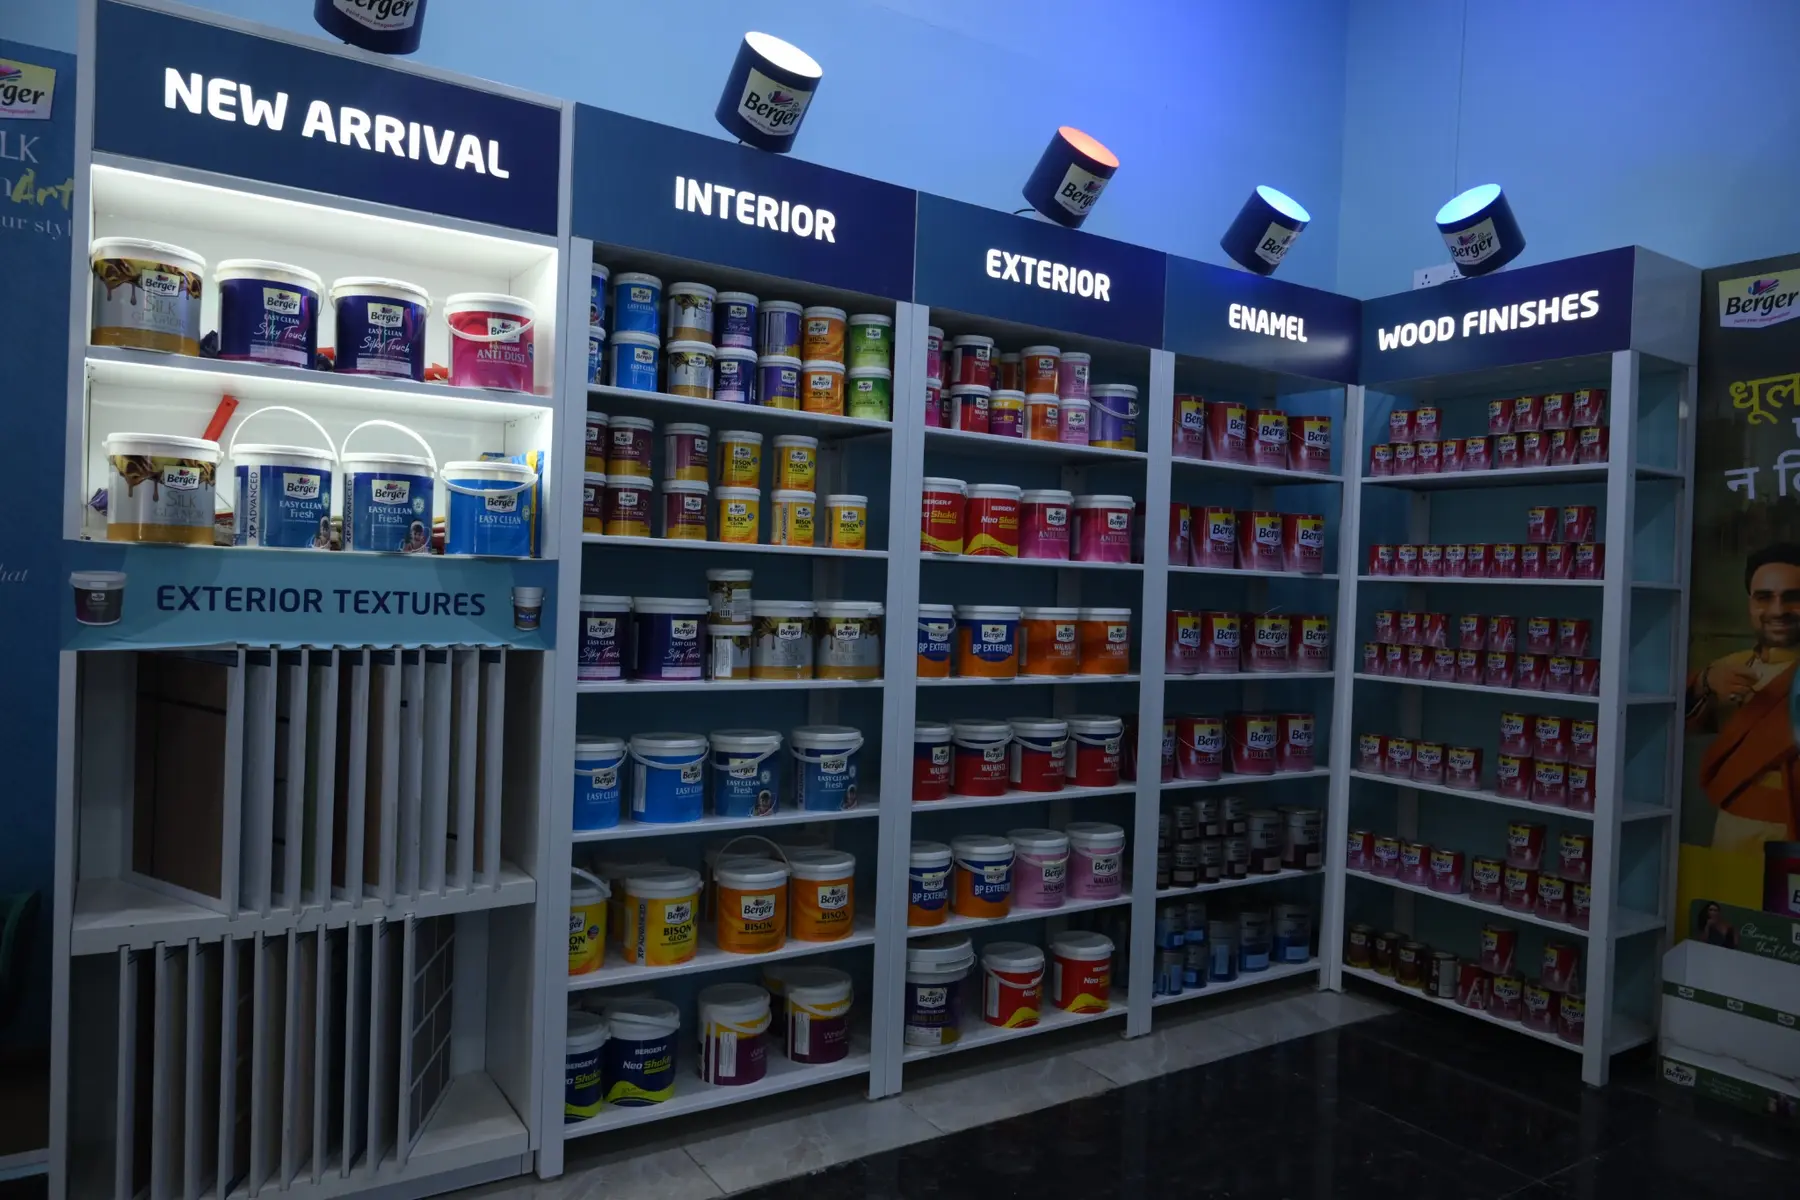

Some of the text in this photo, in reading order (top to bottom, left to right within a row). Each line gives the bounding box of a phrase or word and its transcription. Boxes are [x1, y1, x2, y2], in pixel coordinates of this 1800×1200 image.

[0, 83, 44, 106] ger
[744, 91, 799, 127] Berger
[165, 67, 509, 179] NEW ARRIVAL
[674, 175, 836, 243] INTERIOR
[0, 216, 71, 240] ur styl
[1451, 235, 1493, 258] Berger
[986, 249, 1111, 302] EXTERIOR
[145, 277, 177, 292] Berger
[266, 296, 298, 311] Berger
[1726, 291, 1799, 316] Berger
[264, 313, 300, 325] EASY CLEAN
[370, 311, 400, 325] Berger
[1228, 303, 1307, 343] ENAMEL
[1378, 290, 1599, 351] WOOD FINISHES
[253, 322, 307, 343] Silky Touch
[384, 329, 403, 338] CLEAN
[359, 335, 410, 354] Silky Touch
[477, 348, 525, 363] ANTI DUST
[167, 473, 197, 487] Berger
[286, 482, 318, 496] Berger
[374, 488, 407, 502] Berger
[249, 471, 258, 539] XP ADVANCED
[279, 500, 323, 511] EASY CLEAN
[487, 498, 515, 510] Berger
[290, 509, 314, 519] Fresh
[345, 479, 353, 544] XP ADVANCED
[368, 505, 412, 516] EASY CLEAN
[378, 514, 403, 523] Fresh
[479, 514, 521, 525] EASY CLEAN
[1259, 527, 1280, 541] Berg
[156, 584, 486, 616] EXTERIOR TEXTURES
[589, 625, 613, 635] Berger
[674, 627, 695, 637] Berger
[780, 629, 800, 638] Berger
[837, 630, 858, 639] Berger
[984, 631, 1004, 641] Berger
[1258, 630, 1288, 644] Berger
[580, 646, 621, 661] Silky Touch
[919, 642, 928, 653] BP
[973, 644, 1012, 654] BP EXTERIOR
[664, 648, 684, 662] Silky
[1418, 751, 1440, 763] Berger
[822, 761, 845, 771] Berger
[1536, 769, 1561, 783] Berger
[587, 792, 602, 801] EASY
[676, 787, 690, 795] EASY
[1095, 862, 1118, 873] Berger
[975, 885, 984, 895] BP
[820, 894, 846, 905] Berger
[912, 893, 922, 903] BP
[667, 910, 690, 922] Berger
[744, 905, 773, 916] Berger
[821, 911, 846, 920] BISON
[663, 924, 691, 936] BISON
[744, 921, 773, 931] BISON
[668, 933, 688, 942] GLOW
[638, 947, 644, 959] XP
[919, 995, 943, 1005] Berger
[635, 1046, 662, 1056] BERGER
[1666, 1067, 1693, 1083] Berger
